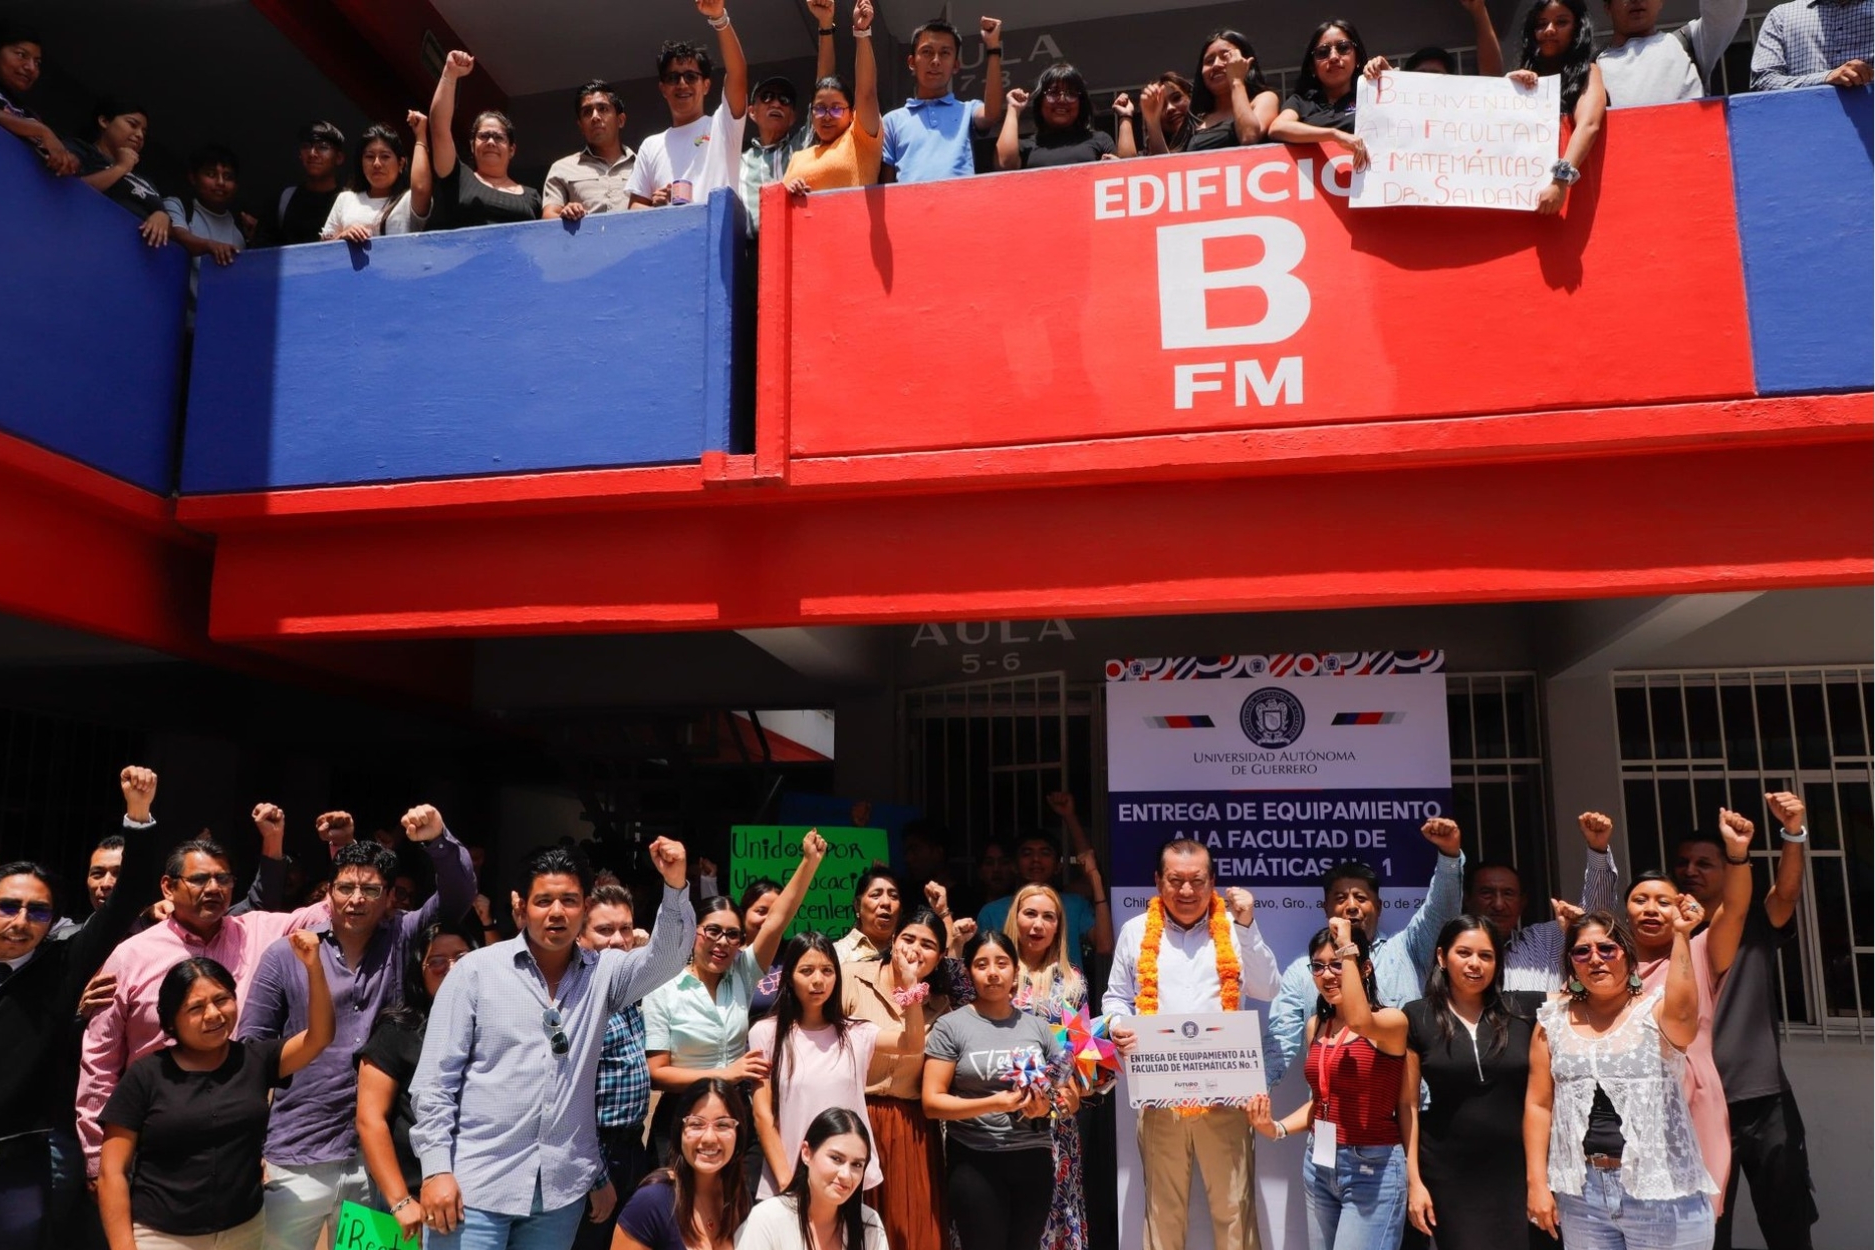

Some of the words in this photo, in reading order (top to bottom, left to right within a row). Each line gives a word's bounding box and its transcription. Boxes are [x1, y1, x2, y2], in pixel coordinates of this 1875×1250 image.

[959, 33, 1064, 70] ULA
[1387, 118, 1413, 138] LA
[1425, 119, 1552, 143] FACULTAD
[1389, 149, 1545, 178] MATEMÁTICAS
[1094, 154, 1354, 220] EDIFICIO
[1156, 215, 1311, 350] B
[1174, 355, 1304, 410] FM
[910, 618, 1076, 648] AULA
[1193, 752, 1275, 764] UNIVERSIDAD
[1279, 750, 1356, 763] AUTÓNOMA
[1251, 763, 1318, 775] GUERRERO
[1118, 803, 1221, 822] ENTREGA
[1226, 803, 1257, 821] DE
[1263, 801, 1442, 822] EQUIPAMIENTO
[1228, 829, 1348, 849] FACULTAD
[1354, 829, 1387, 848] DE
[1213, 852, 1333, 877] EMÁTICAS
[1130, 1052, 1166, 1063] ENTREGA
[1167, 1052, 1177, 1062] DE
[1179, 1050, 1237, 1061] EQUIPAMIENTO
[1239, 1050, 1247, 1059] A
[1247, 1049, 1258, 1059] LA
[1131, 1062, 1169, 1073] FACULTAD
[1171, 1062, 1181, 1072] DE
[1182, 1060, 1237, 1071] MATEMÁTICAS
[1239, 1060, 1253, 1069] No.
[1254, 1060, 1259, 1069] 1
